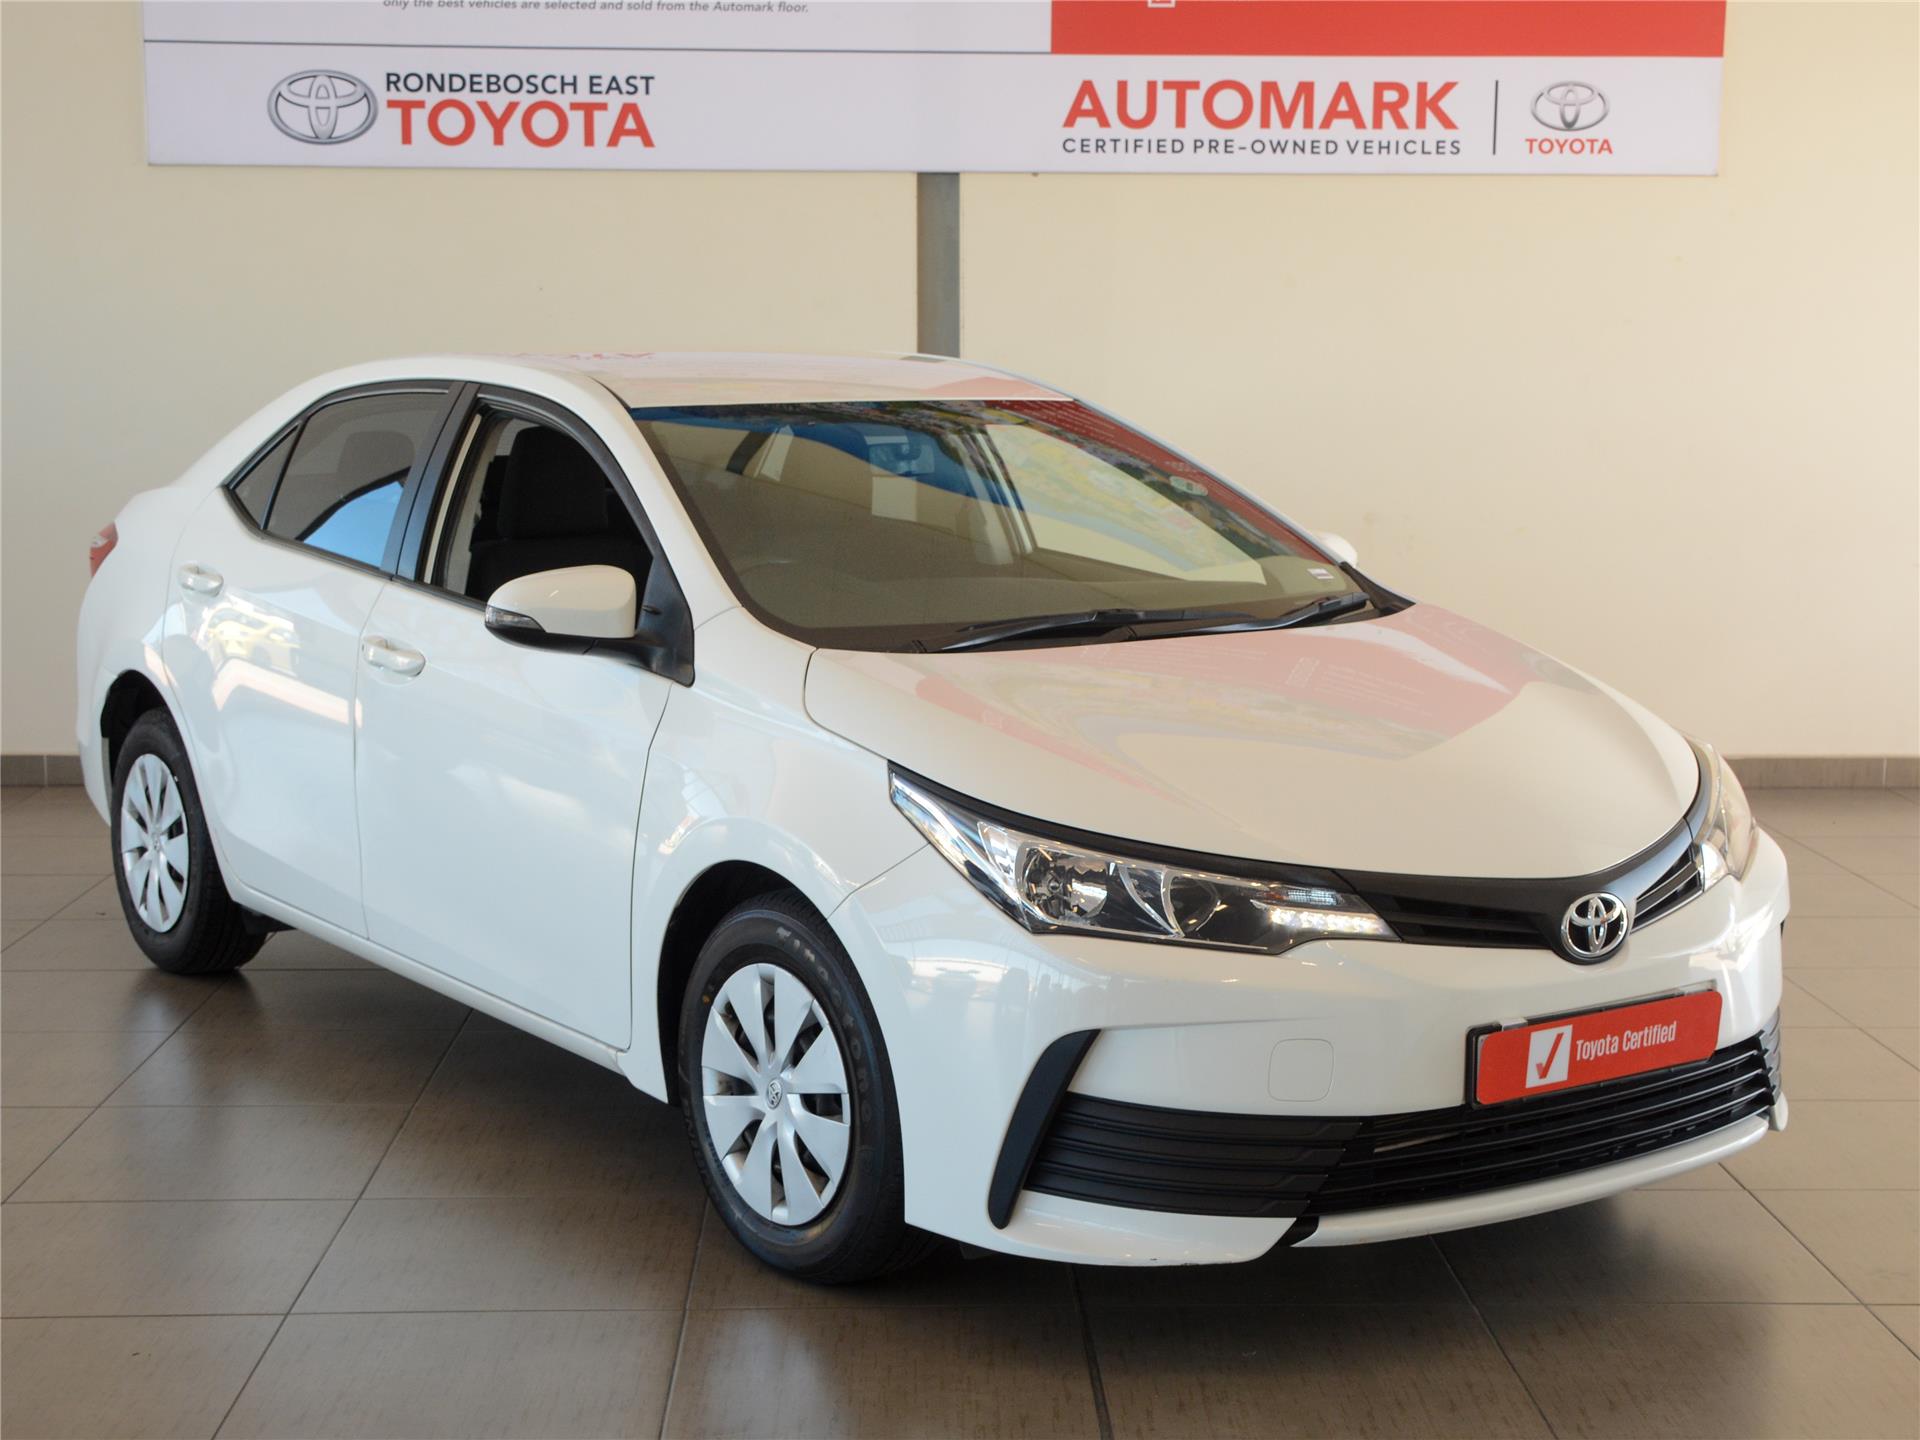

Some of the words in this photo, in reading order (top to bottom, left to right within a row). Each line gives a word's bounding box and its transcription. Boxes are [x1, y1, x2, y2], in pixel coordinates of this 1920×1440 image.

[383, 0, 409, 10] only
[413, 0, 434, 8] the
[437, 0, 464, 8] best
[468, 0, 517, 9] vehicles
[520, 1, 541, 9] are
[544, 0, 597, 10] selected
[600, 0, 624, 10] and
[627, 0, 653, 10] sold
[656, 0, 685, 10] from
[689, 1, 709, 11] the
[711, 1, 773, 12] Automark
[776, 1, 809, 13] floor.
[385, 72, 578, 95] RONDEBOSCH
[588, 75, 655, 96] EAST
[1062, 79, 1460, 131] AUTOMARK
[386, 98, 656, 149] TOYOTA
[1062, 137, 1185, 154] CERTIFIED
[1193, 138, 1339, 155] PRE-OWNED
[1346, 139, 1461, 156] VEHICLES
[1525, 137, 1613, 156] TOYOTA
[1575, 1033, 1619, 1062] Toyota
[1622, 1020, 1677, 1052] Certified
